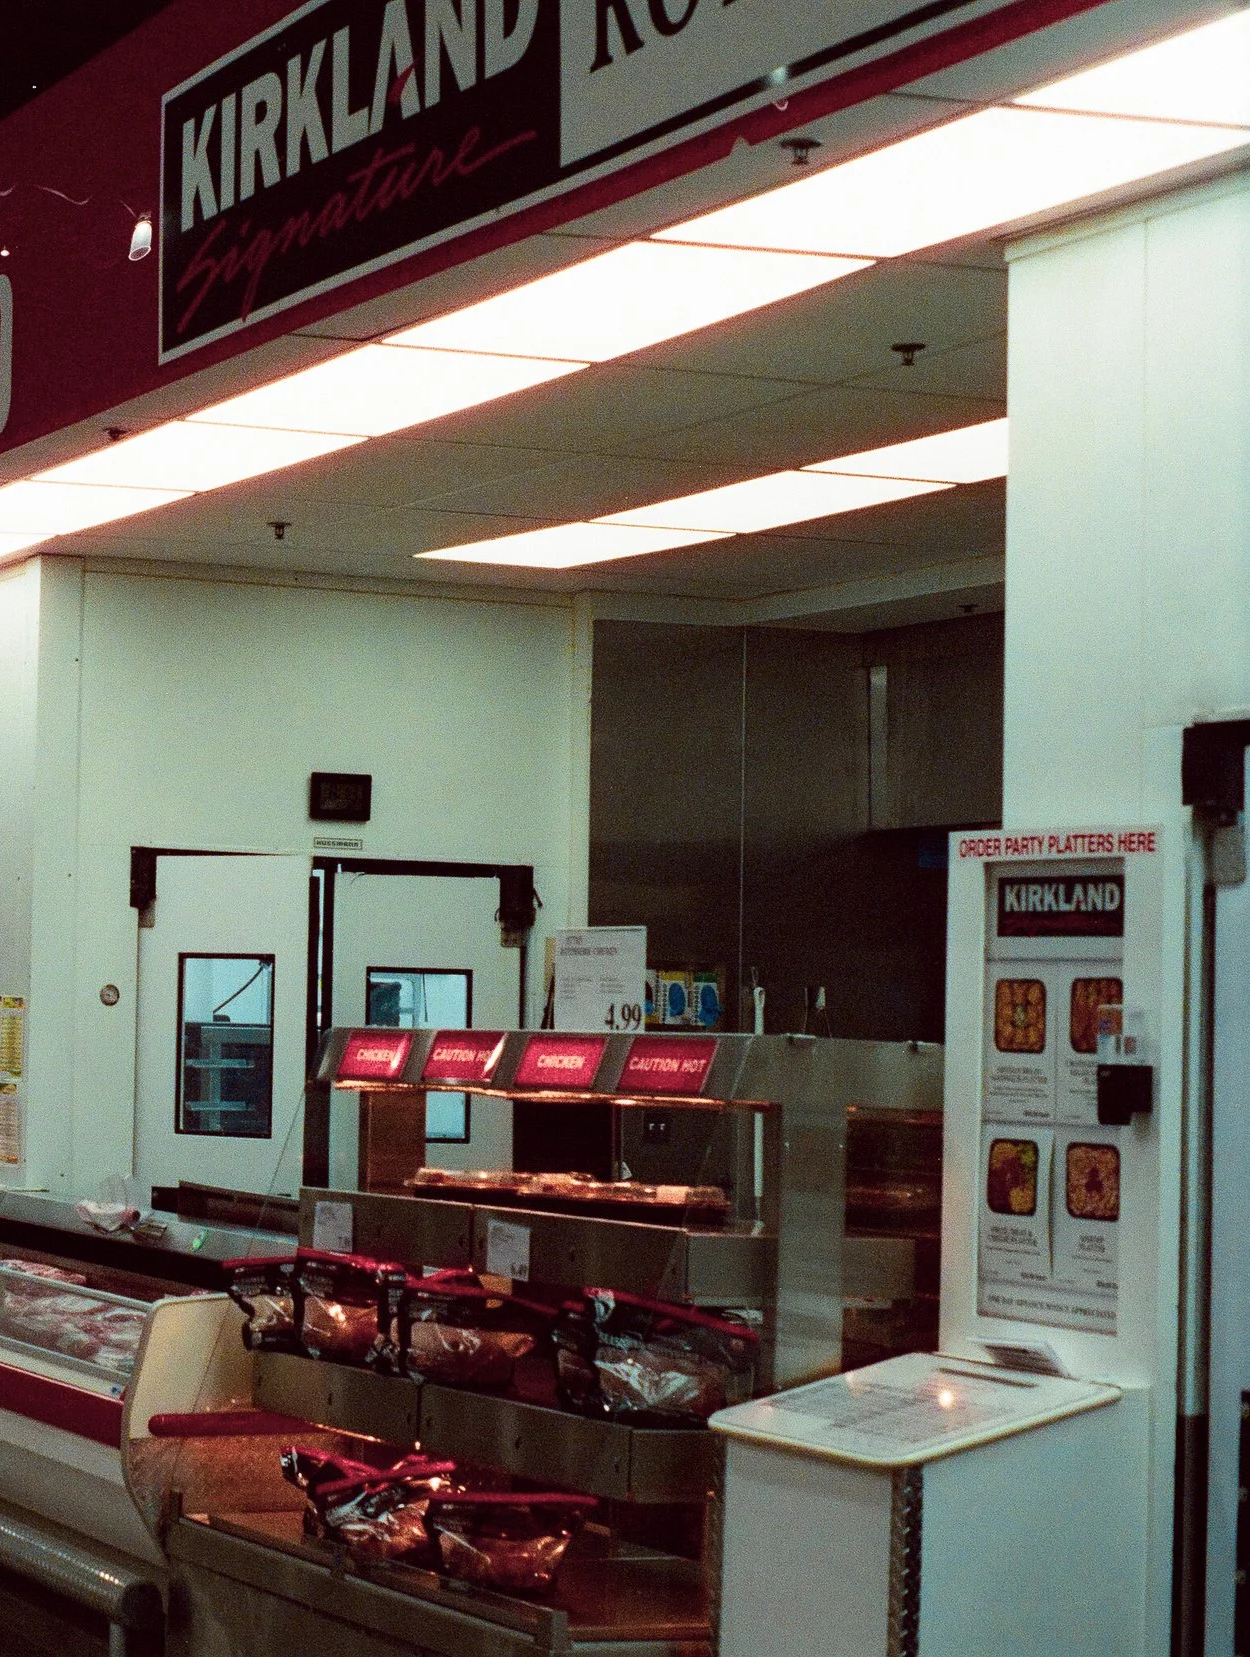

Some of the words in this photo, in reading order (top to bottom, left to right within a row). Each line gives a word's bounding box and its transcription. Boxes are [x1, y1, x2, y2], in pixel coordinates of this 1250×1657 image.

[180, 0, 539, 233] KIRKLAND
[177, 126, 537, 333] Signature
[959, 838, 1002, 858] ORDER
[1005, 835, 1045, 855] PARTY
[1048, 833, 1114, 854] PLATTERS
[1118, 832, 1156, 853] HERE
[1004, 882, 1121, 913] KIRKLAND
[604, 1002, 642, 1031] 4.99
[356, 1048, 395, 1062] CHICKEN
[433, 1048, 476, 1062] CAUTION
[536, 1053, 584, 1069] CHICKEN
[628, 1056, 679, 1072] CAUTION
[681, 1058, 707, 1073] HOT
